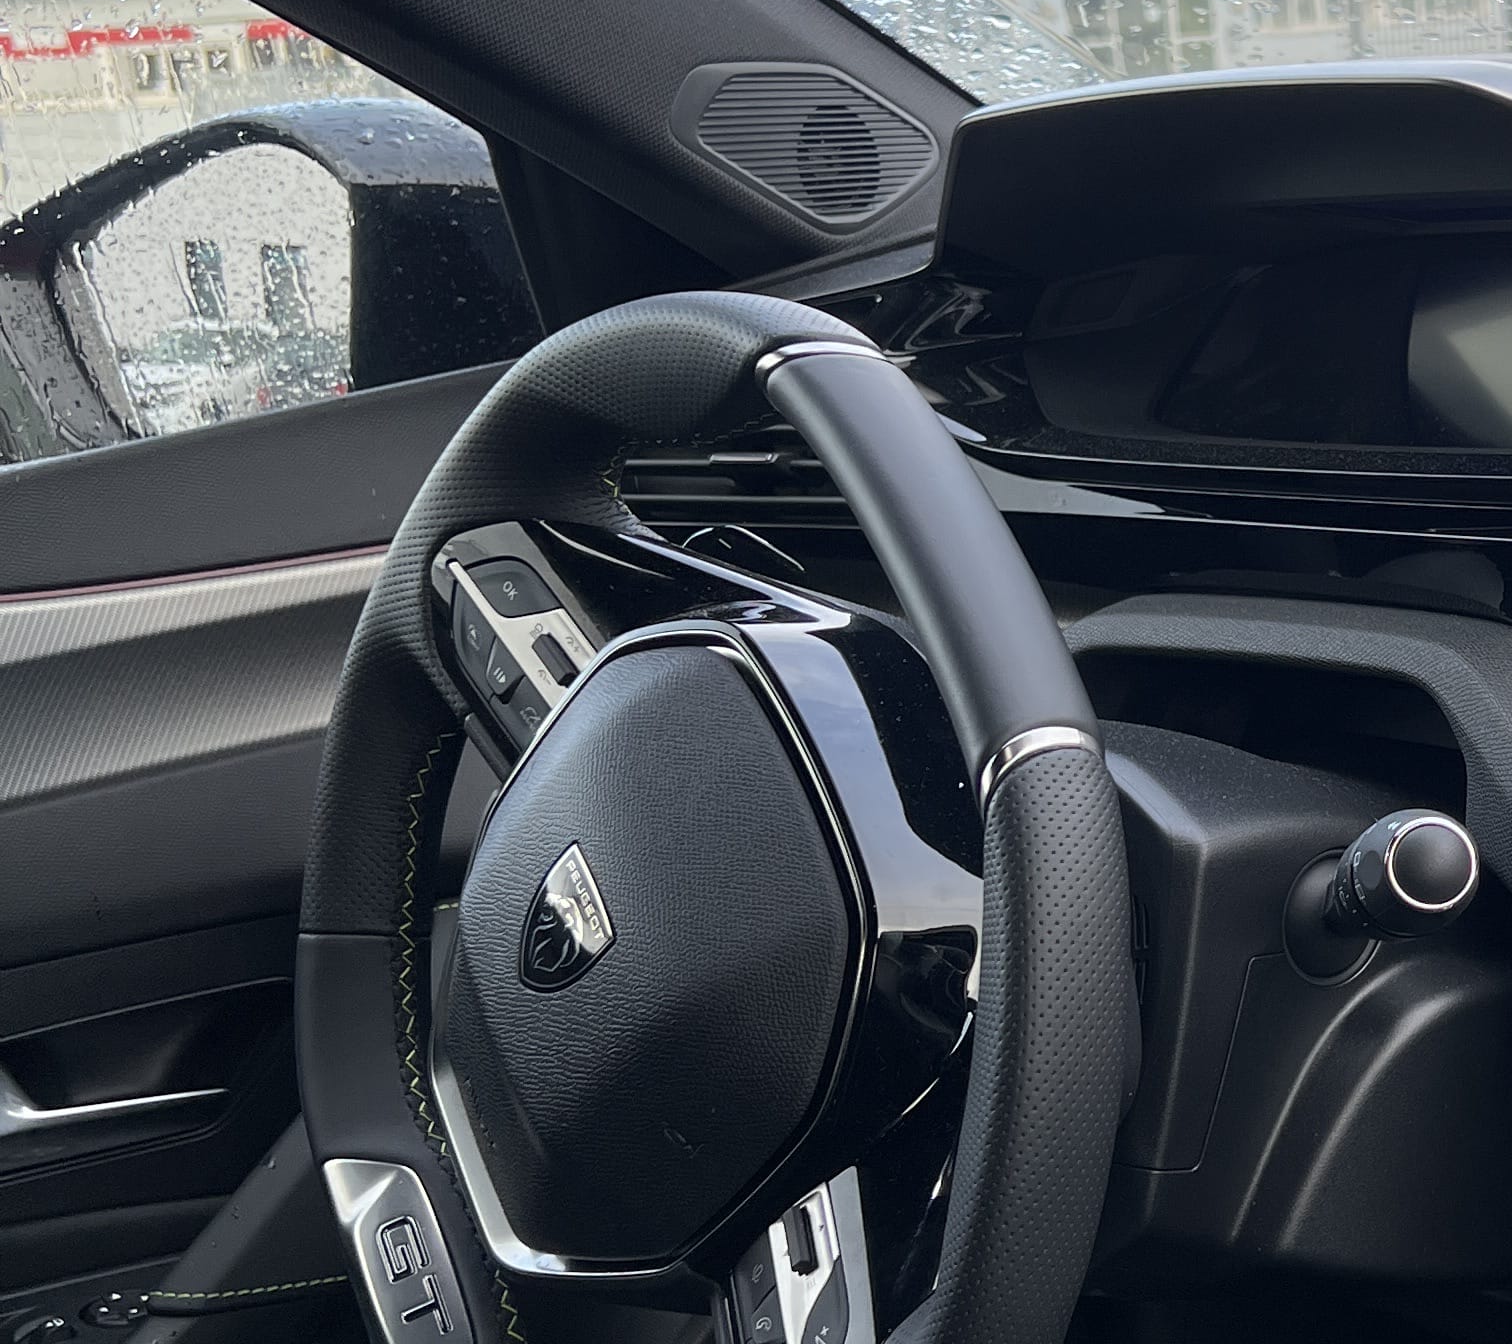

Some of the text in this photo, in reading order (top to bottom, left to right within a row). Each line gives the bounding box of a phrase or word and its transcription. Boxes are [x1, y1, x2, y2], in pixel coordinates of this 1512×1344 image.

[502, 580, 519, 601] OK
[565, 859, 605, 940] PEUGEOT
[375, 1215, 454, 1336] GT
